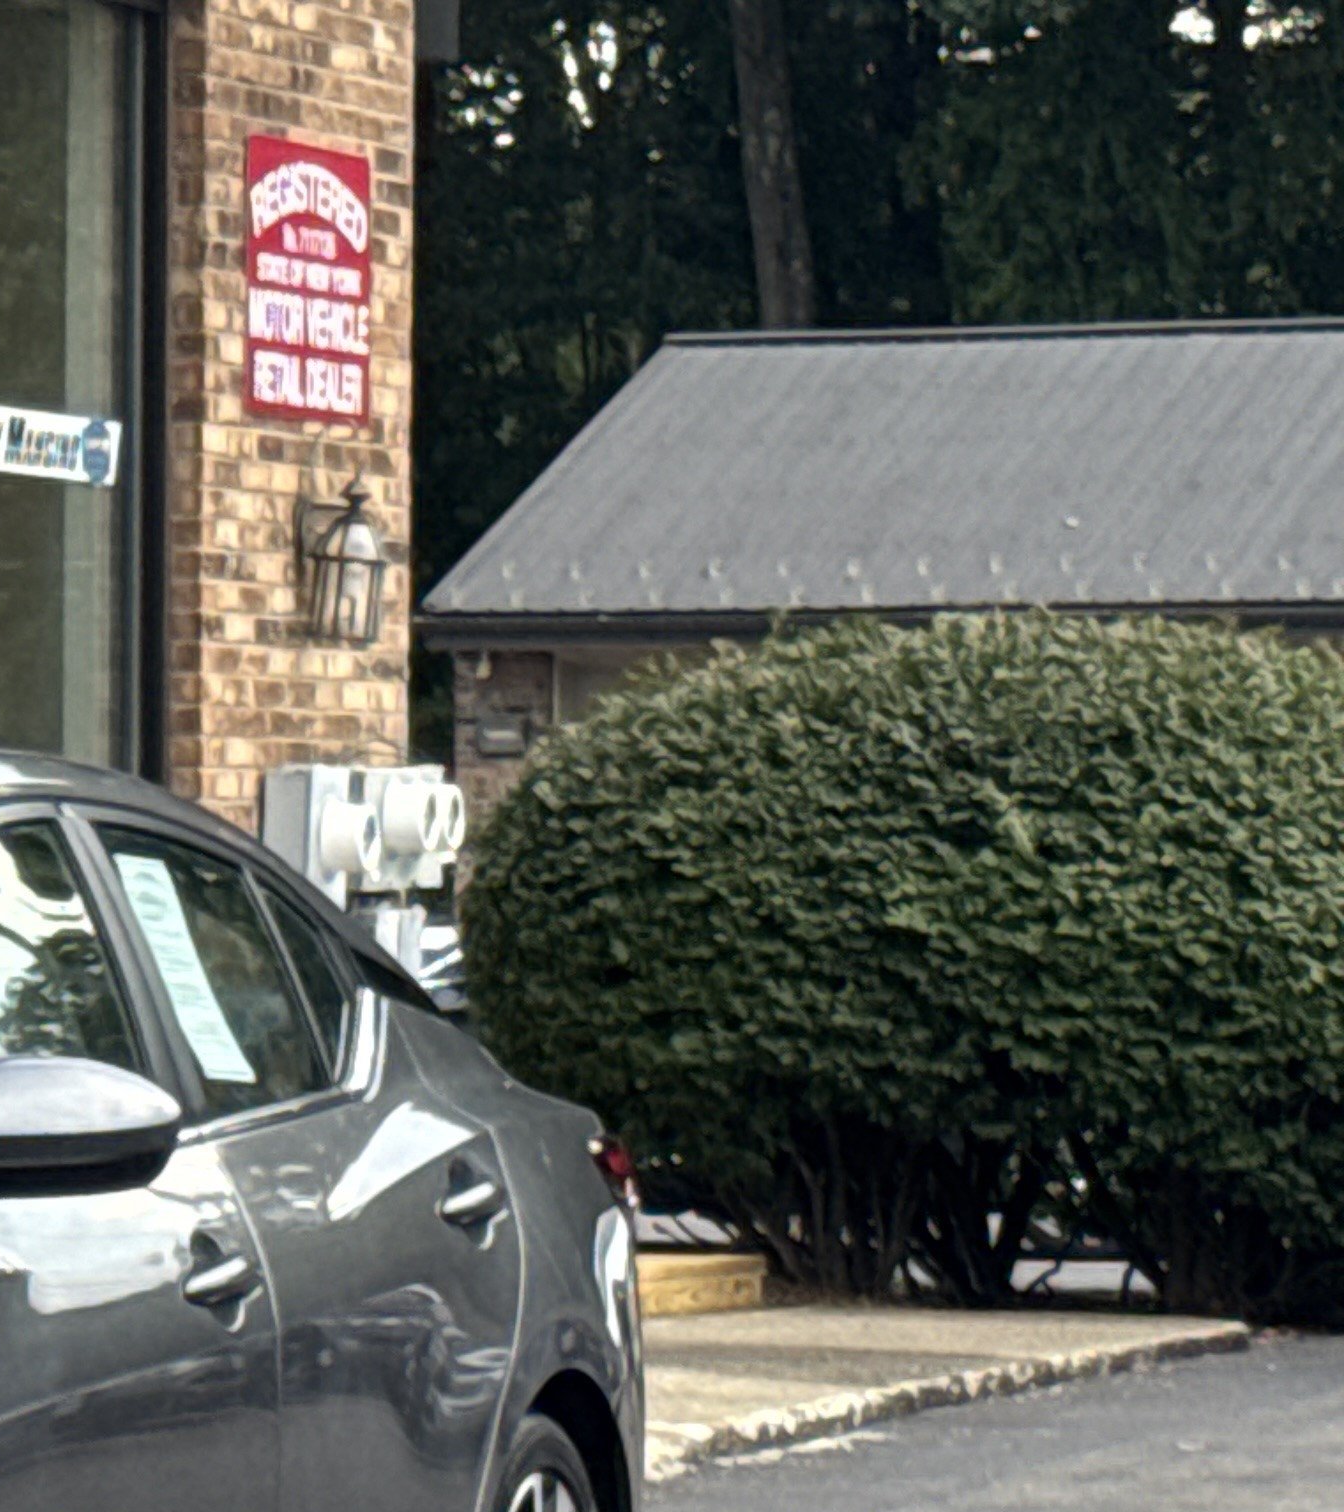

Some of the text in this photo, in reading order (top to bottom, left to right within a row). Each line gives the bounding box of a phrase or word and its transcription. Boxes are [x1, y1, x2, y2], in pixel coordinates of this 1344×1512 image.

[249, 160, 368, 254] REGISTERED
[248, 286, 369, 357] MOTOR VEHICLE
[253, 348, 362, 417] RETAIL DEALER
